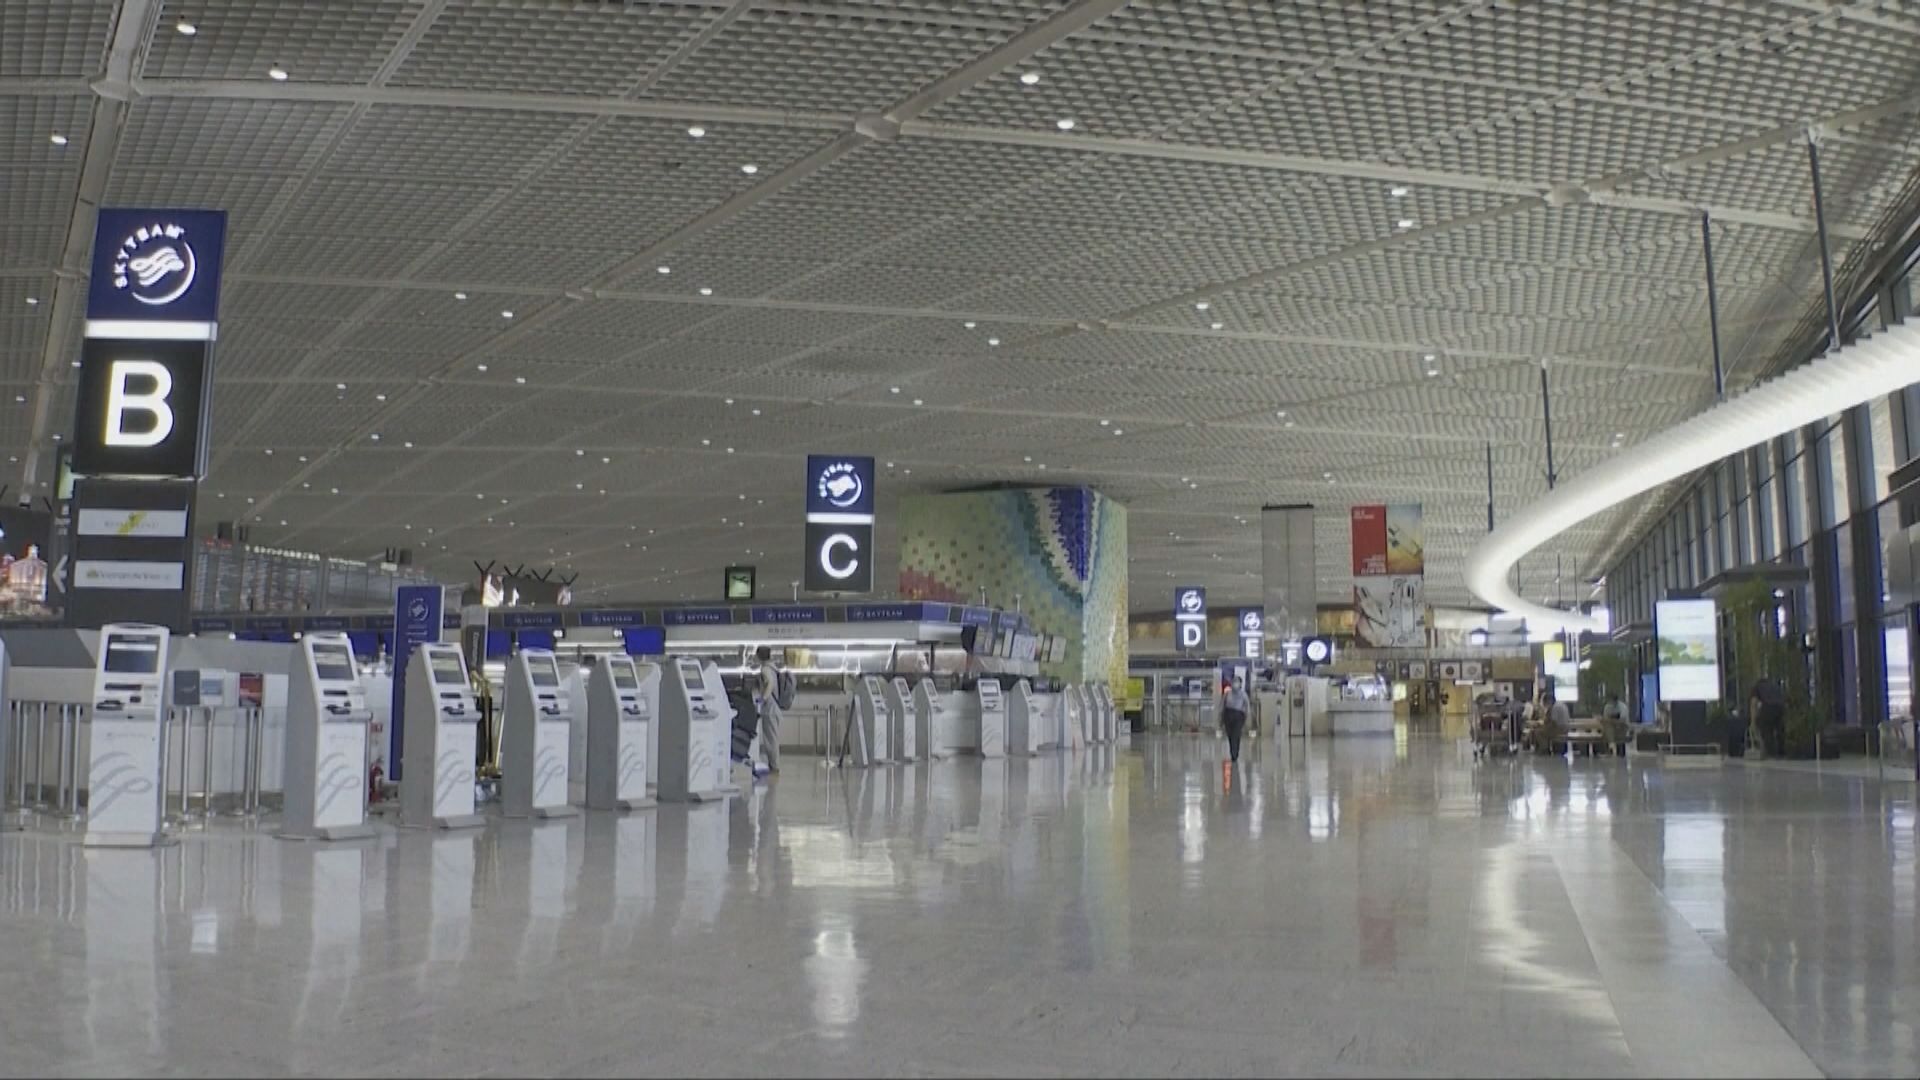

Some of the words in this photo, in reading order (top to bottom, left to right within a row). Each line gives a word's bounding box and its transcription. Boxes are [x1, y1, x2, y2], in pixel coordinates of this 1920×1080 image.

[104, 359, 175, 448] B
[820, 533, 858, 579] C
[1183, 623, 1202, 647] D
[1245, 638, 1260, 658] E
[1286, 649, 1298, 665] F
